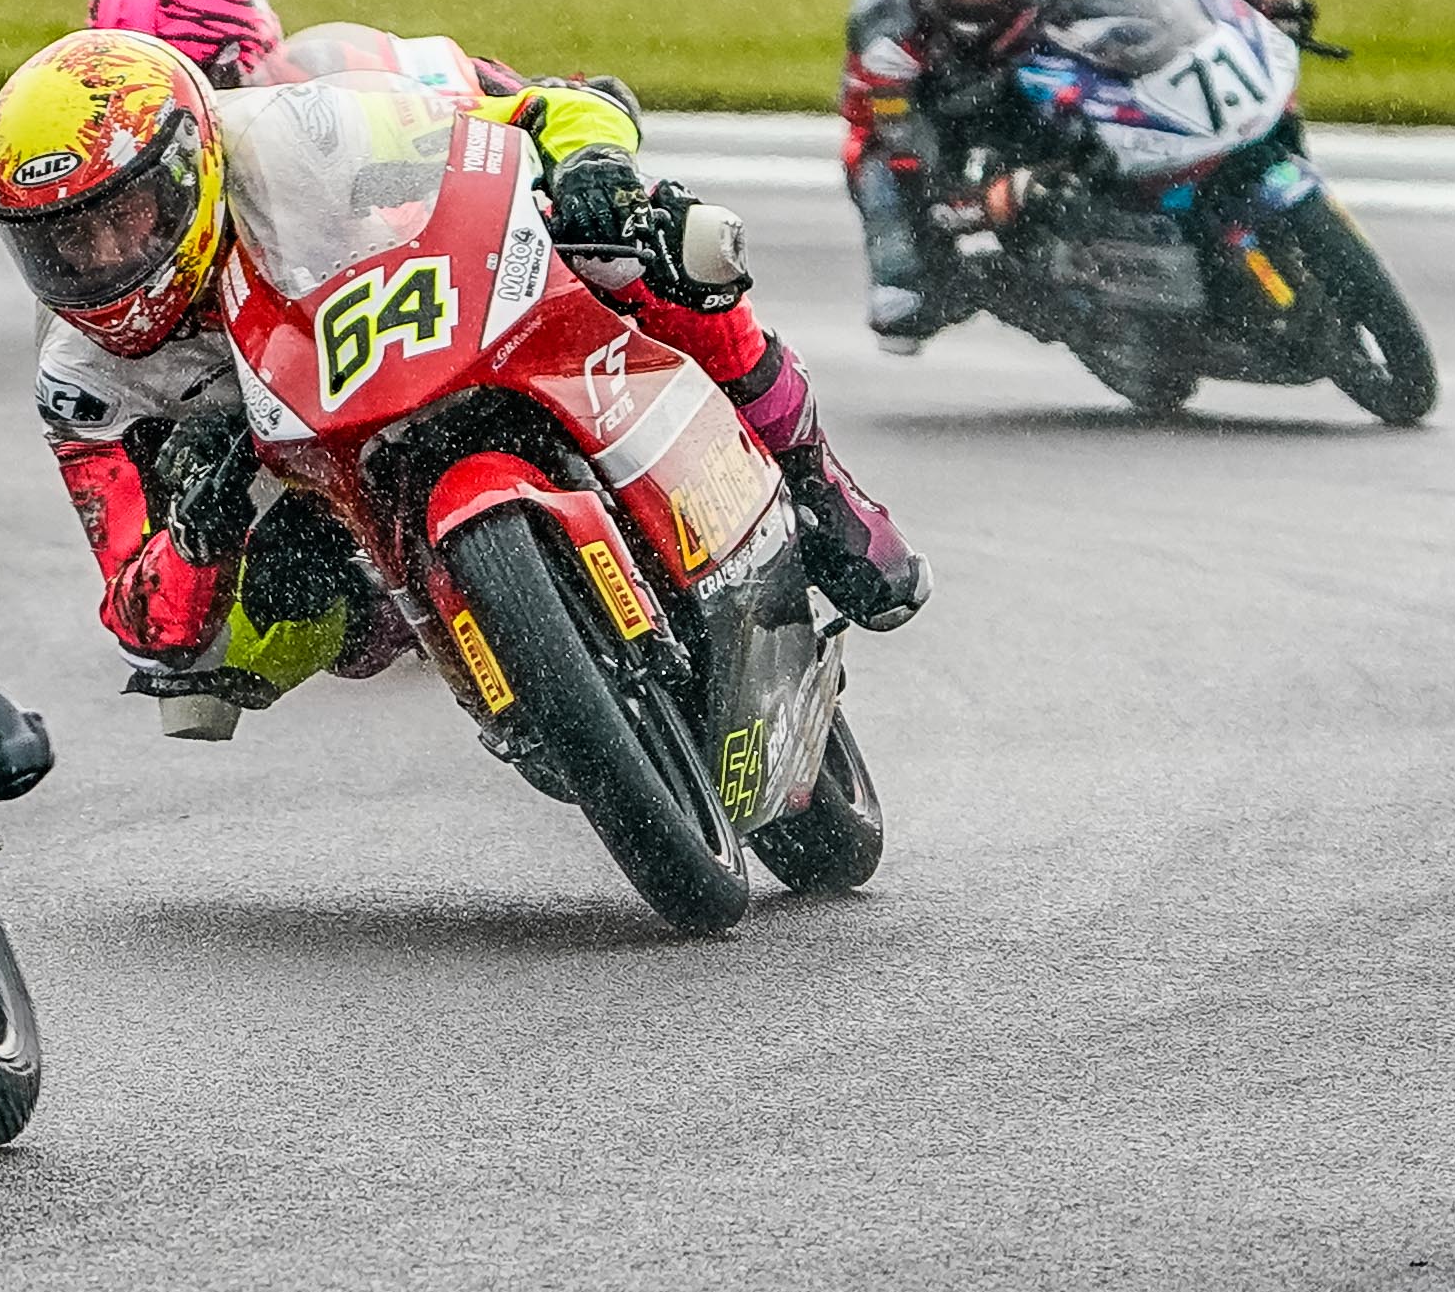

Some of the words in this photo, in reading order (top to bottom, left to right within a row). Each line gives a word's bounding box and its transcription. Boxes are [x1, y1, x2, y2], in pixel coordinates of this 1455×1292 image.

[1168, 46, 1268, 134] 71
[21, 156, 71, 182] HJC
[463, 117, 489, 173] YORKSHIRE
[497, 227, 536, 302] Moto4
[524, 256, 541, 298] BRITISH
[534, 239, 545, 258] CUP
[320, 263, 447, 403] 64
[589, 550, 642, 630] PIRELLI
[720, 719, 764, 823] 64
